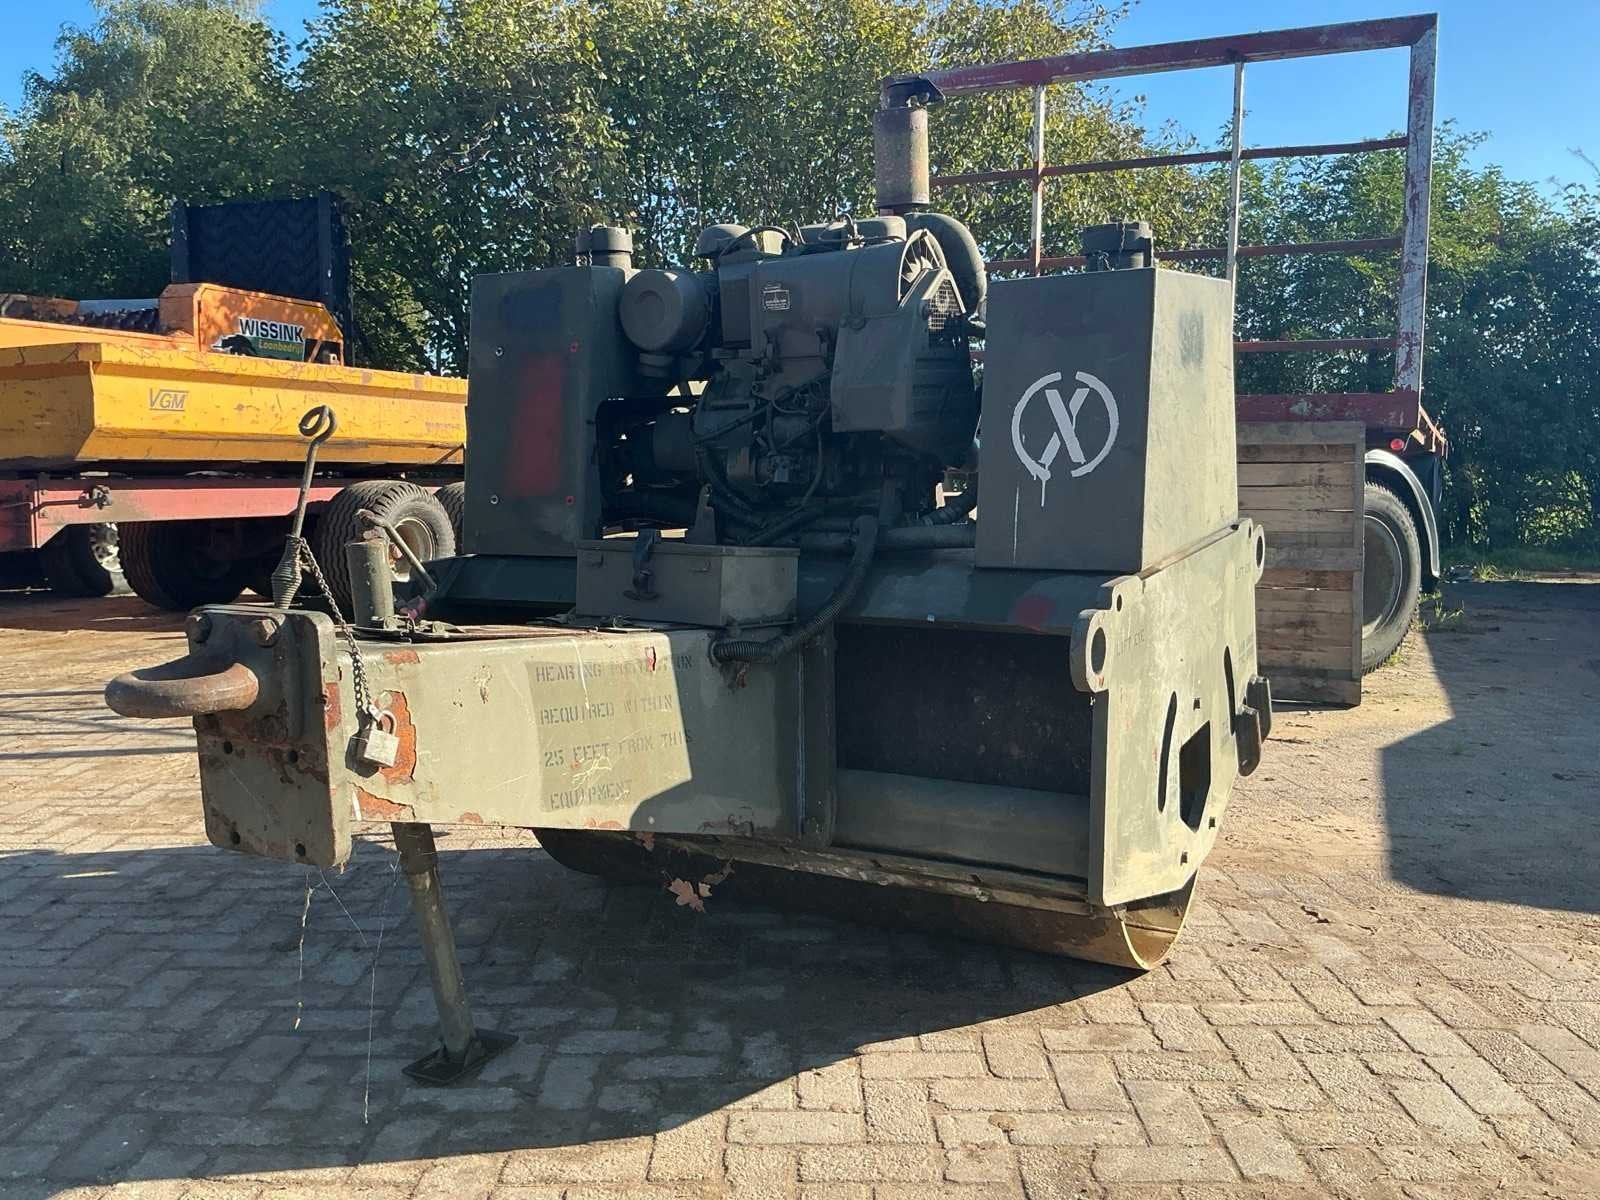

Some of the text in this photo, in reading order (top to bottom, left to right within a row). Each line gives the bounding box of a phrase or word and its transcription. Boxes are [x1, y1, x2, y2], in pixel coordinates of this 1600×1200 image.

[239, 318, 304, 342] WISSINK
[149, 388, 188, 411] VGM
[535, 664, 602, 682] HEARING
[540, 694, 673, 725] REQUIRED WITHIN
[544, 749, 565, 767] 25
[573, 742, 609, 762] FEET
